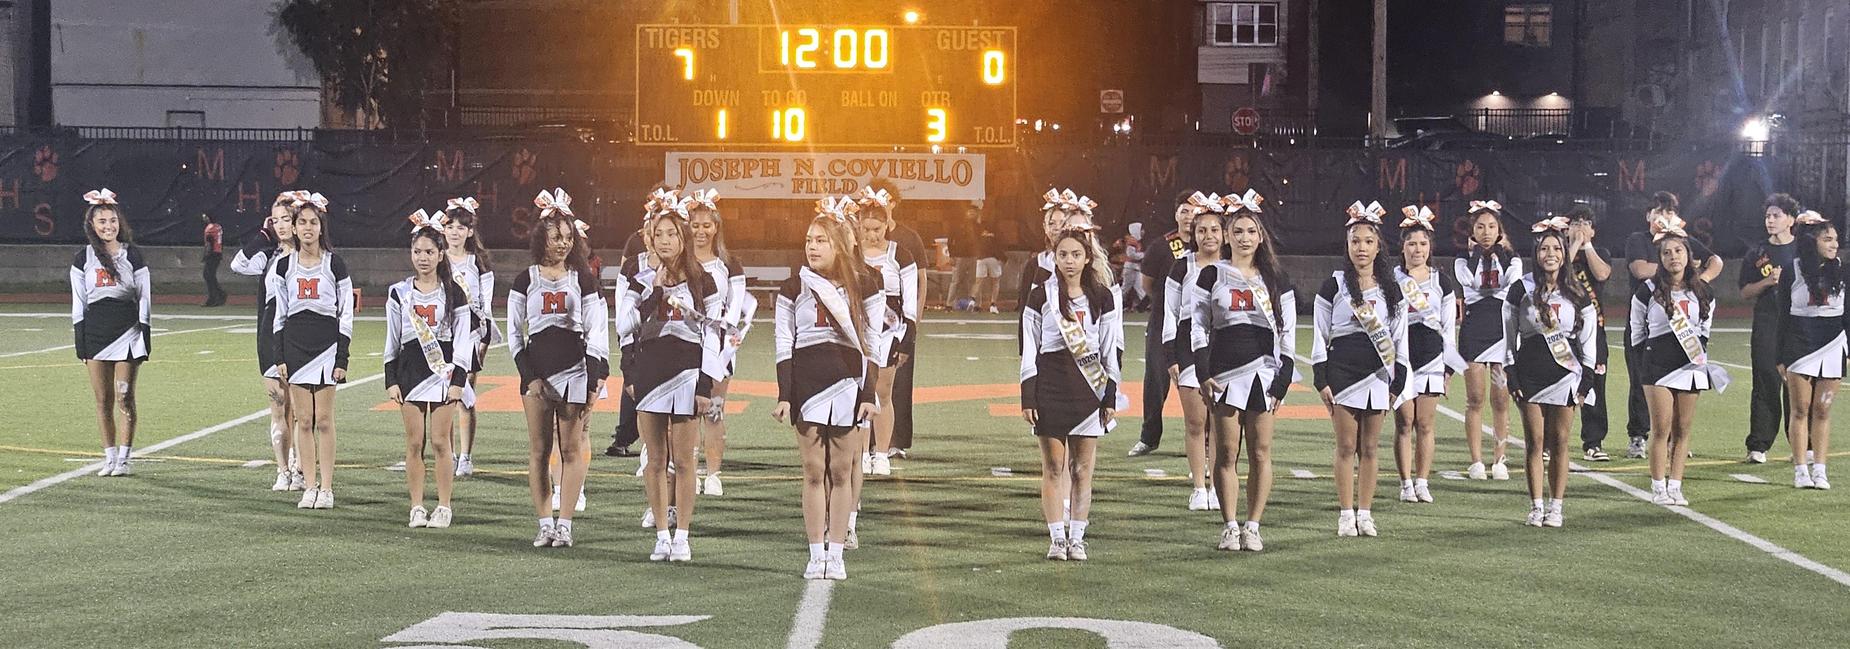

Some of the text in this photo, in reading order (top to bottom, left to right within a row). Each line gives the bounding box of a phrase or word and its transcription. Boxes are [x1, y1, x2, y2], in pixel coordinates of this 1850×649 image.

[645, 28, 720, 49] TIGERS
[781, 28, 888, 69] 12:00
[936, 30, 1006, 50] GUEST
[674, 48, 694, 80] 7
[983, 50, 1004, 85] 0
[693, 90, 739, 106] DOWN
[761, 90, 807, 106] TO GO
[841, 91, 897, 107] BALL ON
[641, 125, 679, 141] T.O.L.
[717, 108, 727, 139] 1
[773, 107, 805, 141] 10
[927, 108, 946, 142] 3
[974, 126, 1011, 143] T.O.L.
[677, 157, 782, 190] JOSEPH
[828, 158, 973, 187] COVIELLO
[791, 177, 859, 194] FIELD
[296, 278, 320, 299] M
[541, 291, 568, 315] M
[1229, 288, 1256, 312] M
